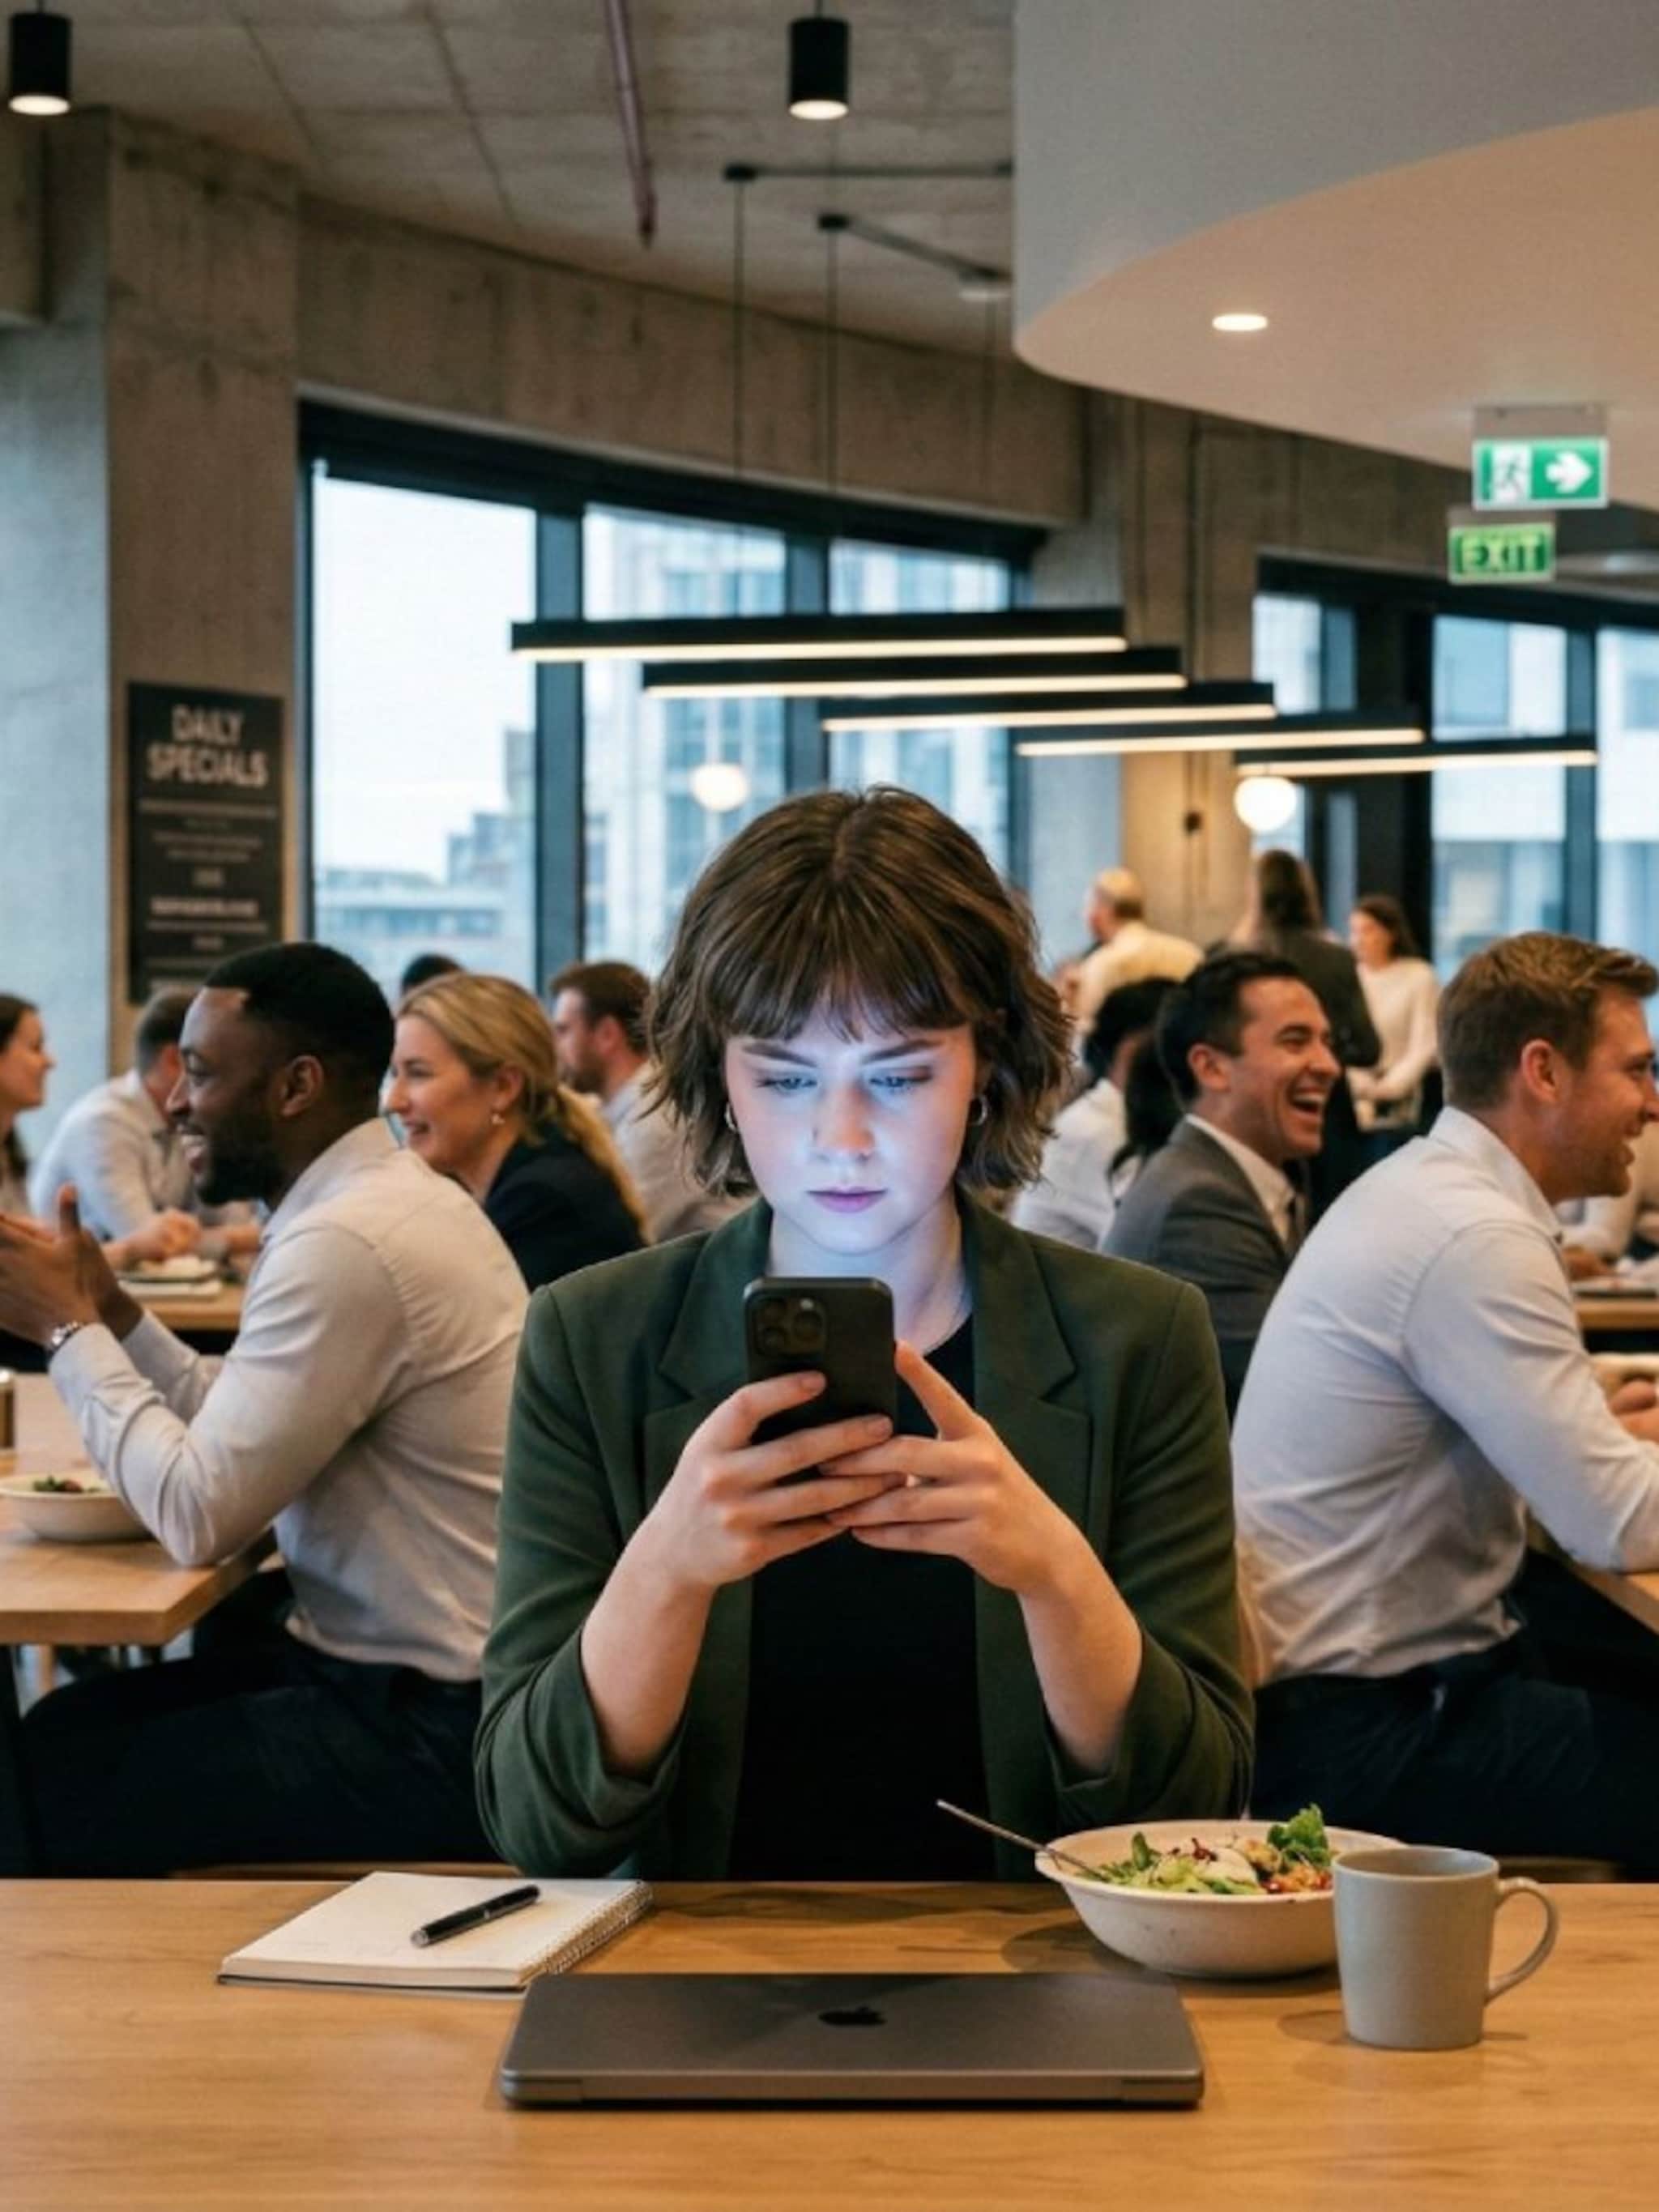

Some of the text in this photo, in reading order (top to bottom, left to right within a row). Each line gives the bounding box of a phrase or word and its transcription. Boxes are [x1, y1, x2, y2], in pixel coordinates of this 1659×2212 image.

[1462, 533, 1540, 572] EXIT
[173, 705, 242, 744] DAILY
[147, 743, 268, 786] SPECIALS
